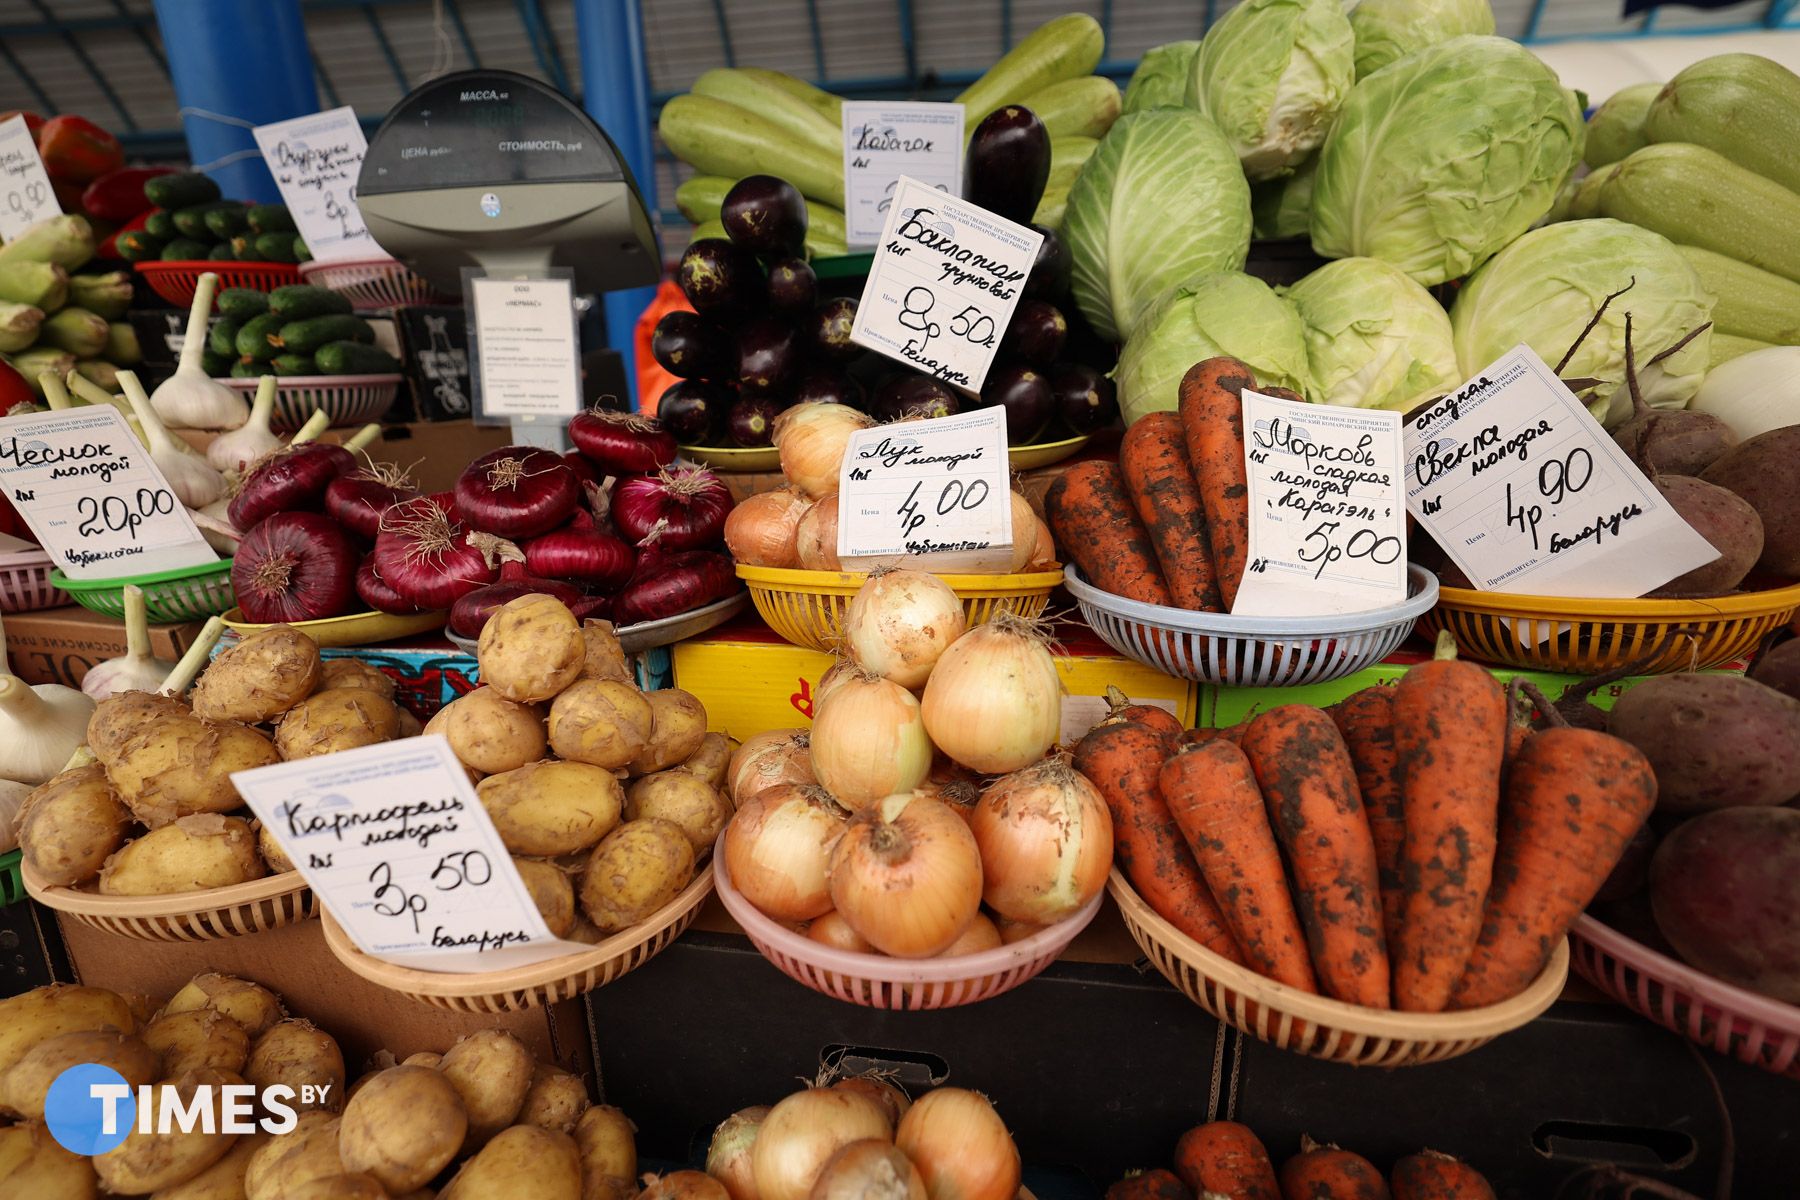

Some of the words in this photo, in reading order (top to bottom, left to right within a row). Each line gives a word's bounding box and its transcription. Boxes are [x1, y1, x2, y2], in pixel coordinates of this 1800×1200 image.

[460, 90, 499, 102] МАССА,
[401, 147, 428, 159] ЦЕНА
[898, 208, 1025, 283] Баклажан
[881, 292, 899, 305] Цена
[1252, 418, 1376, 471] Морковь
[1414, 424, 1502, 487] Свекла
[50, 456, 130, 483] молодой
[1538, 447, 1593, 505] 90
[861, 508, 880, 516] Цена
[1266, 512, 1283, 522] Цена
[48, 519, 68, 527] Цена
[1465, 532, 1487, 547] Цена
[1486, 557, 1539, 588] Производитель
[430, 850, 492, 891] 50
